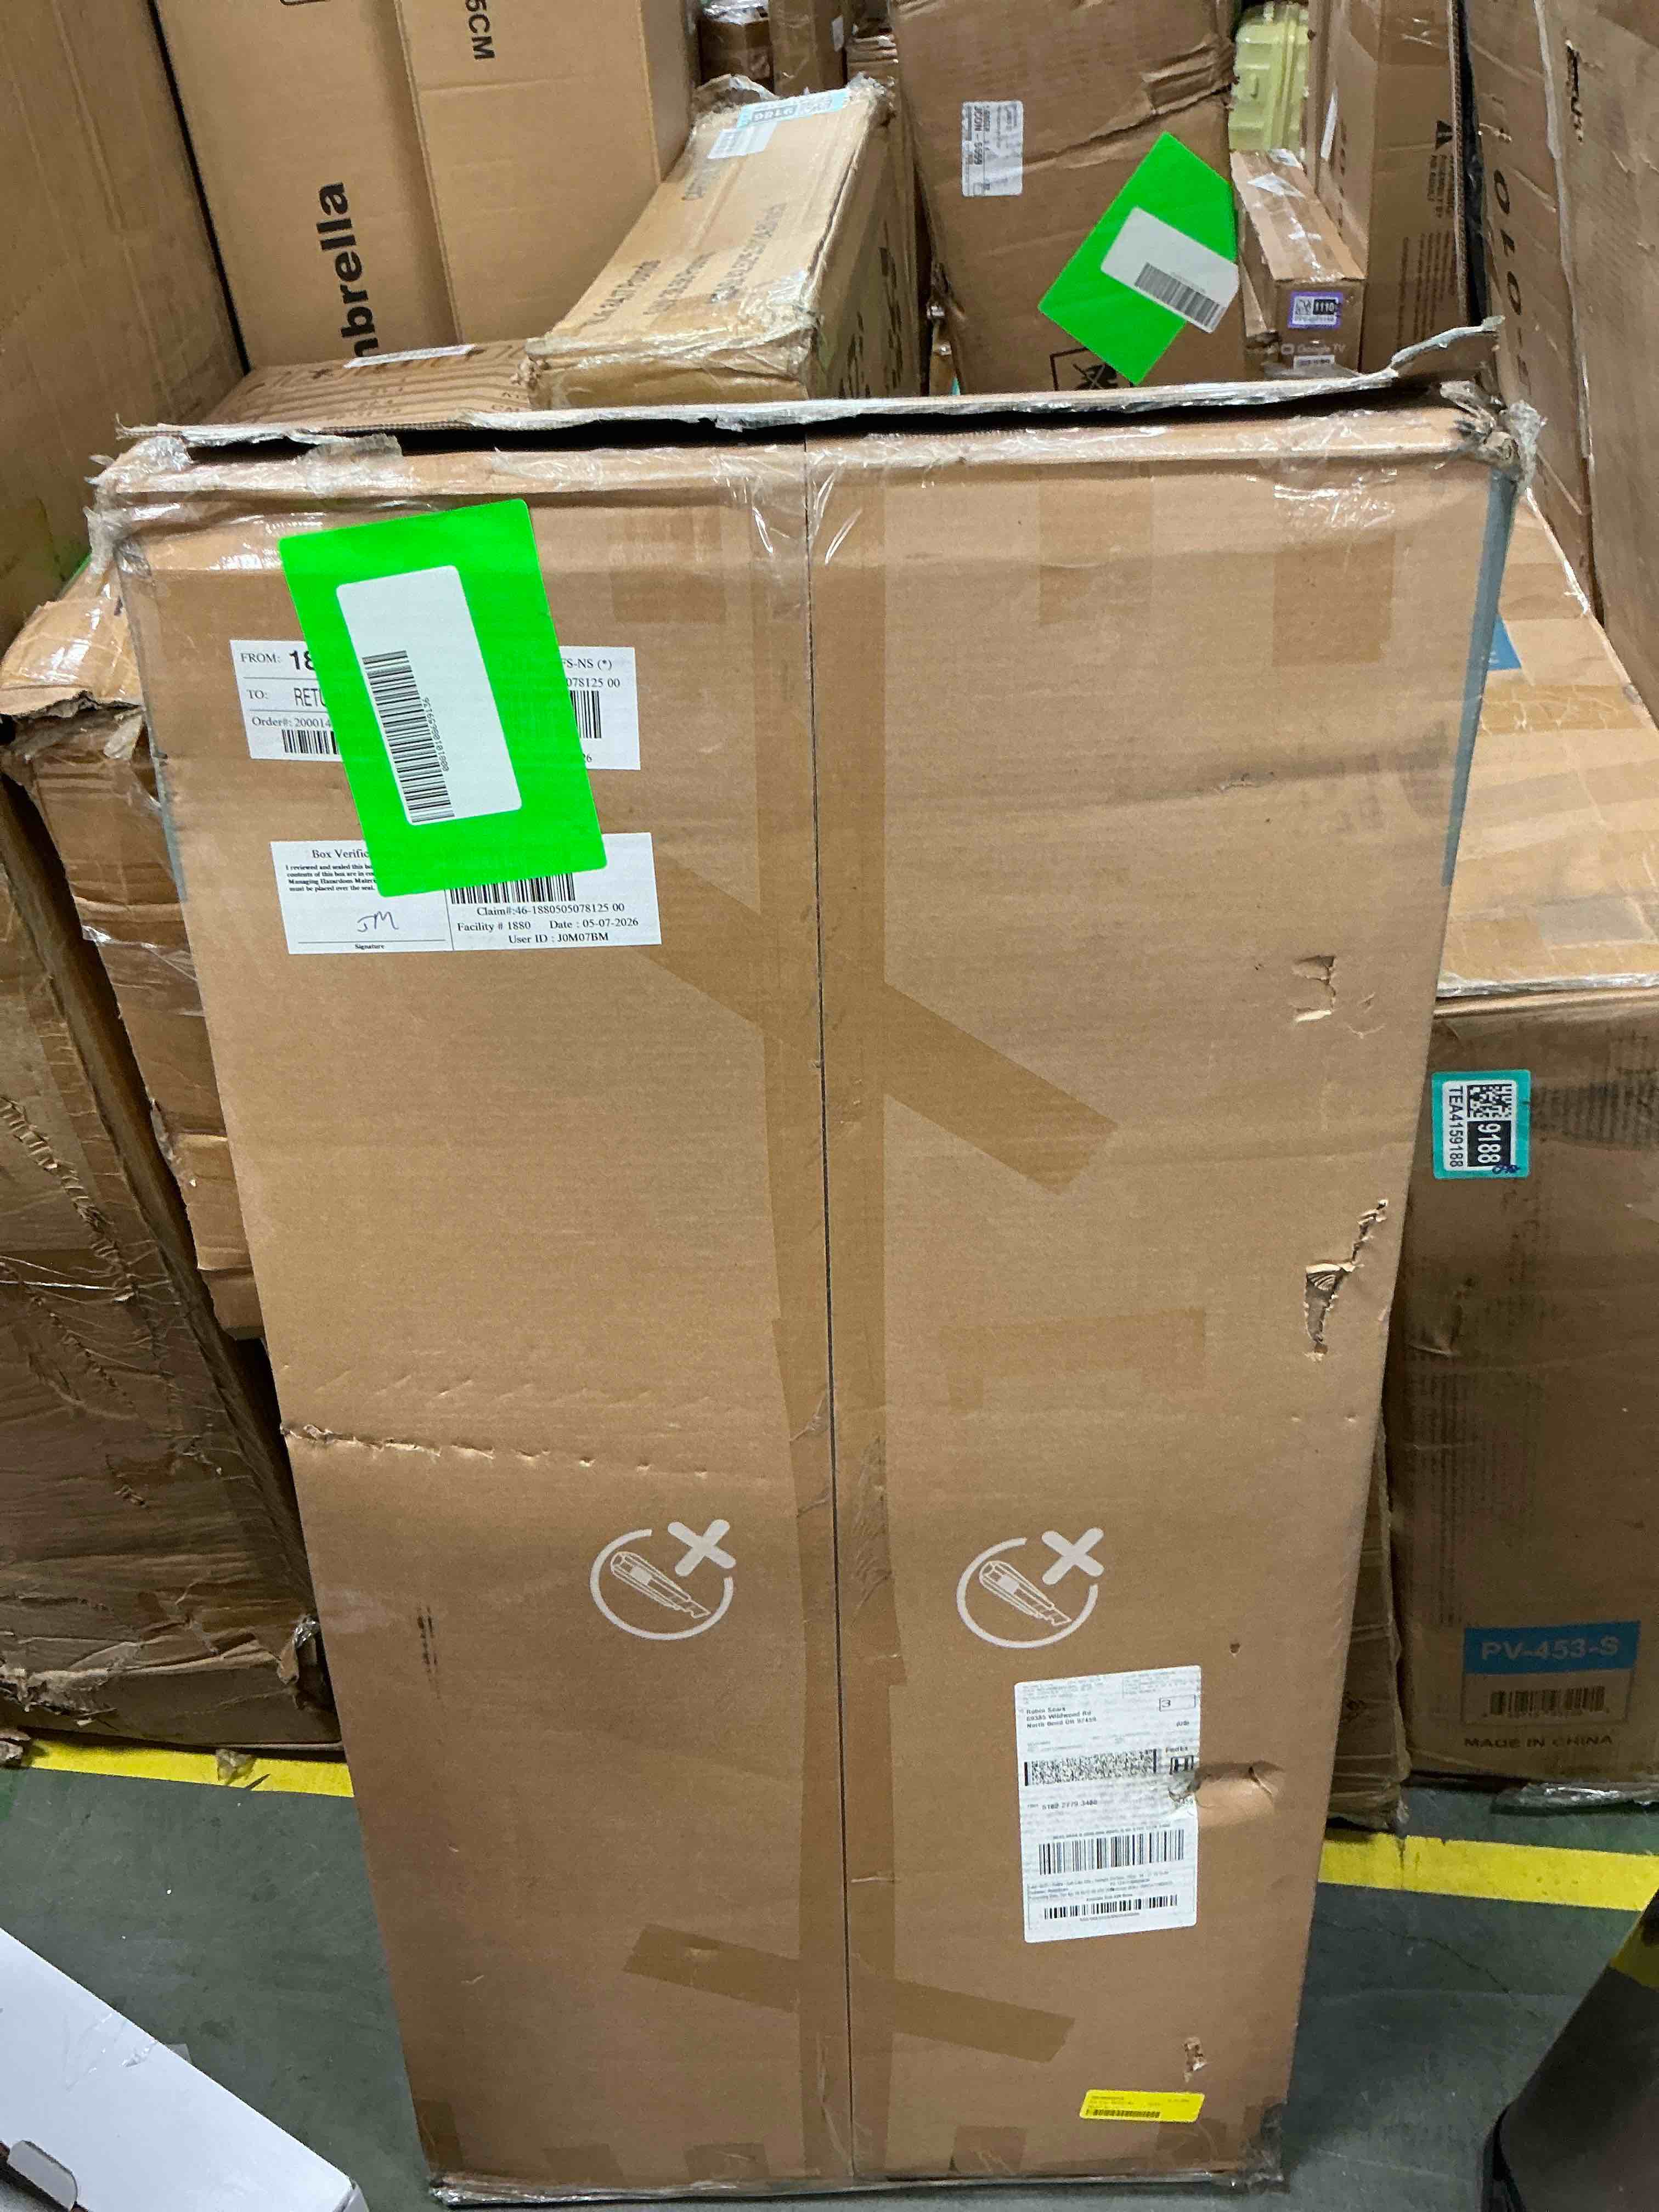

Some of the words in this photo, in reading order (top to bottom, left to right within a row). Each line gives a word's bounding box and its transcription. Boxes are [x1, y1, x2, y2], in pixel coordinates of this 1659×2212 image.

[241, 653, 281, 663] FROM:
[607, 678, 620, 687] 00
[247, 690, 268, 699] TO:
[252, 716, 292, 726] Order#:
[312, 850, 331, 858] Box
[612, 902, 625, 912] 00
[457, 922, 494, 933] Facility
[507, 921, 531, 931] 1880
[550, 919, 573, 929] Date
[582, 917, 639, 928] 05-07-2026
[509, 934, 532, 944] User
[535, 934, 548, 943] ID
[1448, 1086, 1464, 1167] TEA4159188
[1477, 1123, 1502, 1164] 9188
[1481, 1635, 1619, 1660] PV-453-S
[1464, 1737, 1521, 1748] MADE
[1527, 1737, 1545, 1747] IN
[1552, 1735, 1612, 1747] CHINA
